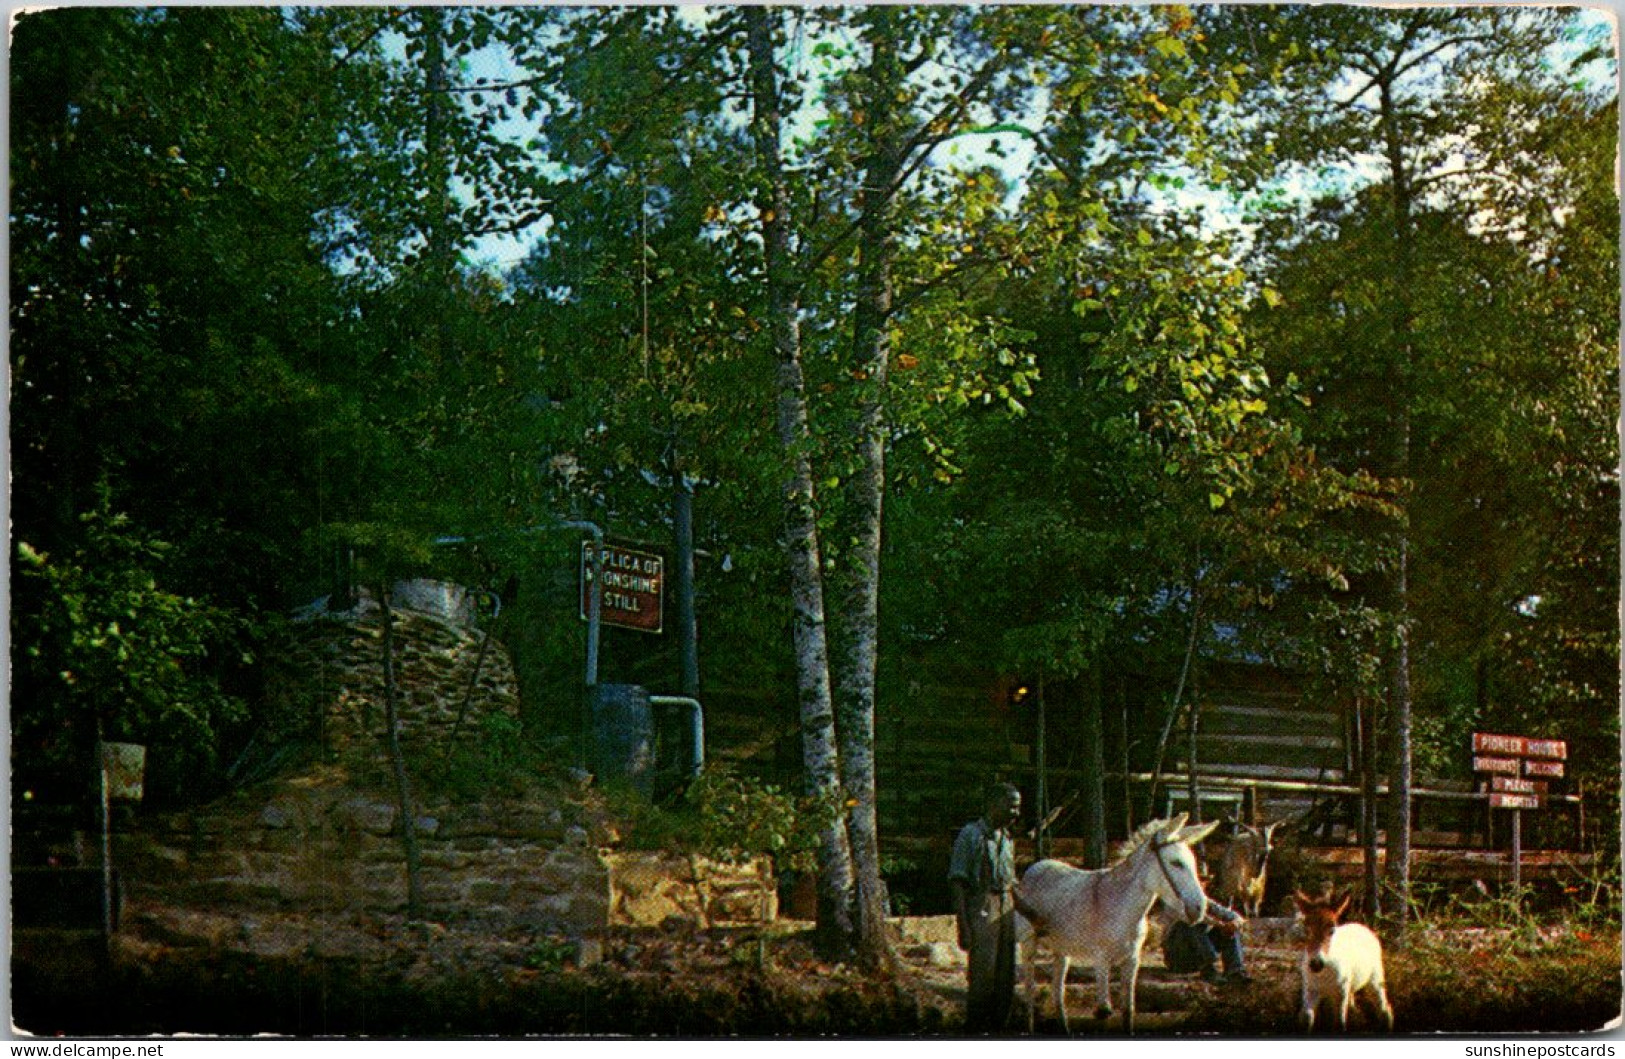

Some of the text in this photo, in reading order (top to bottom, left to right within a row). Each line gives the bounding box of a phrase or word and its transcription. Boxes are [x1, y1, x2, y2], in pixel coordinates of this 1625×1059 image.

[585, 547, 660, 575] RPLICA OF
[585, 567, 658, 594] MONSHINE
[604, 591, 640, 612] STILL
[1480, 735, 1522, 753] PIONEER
